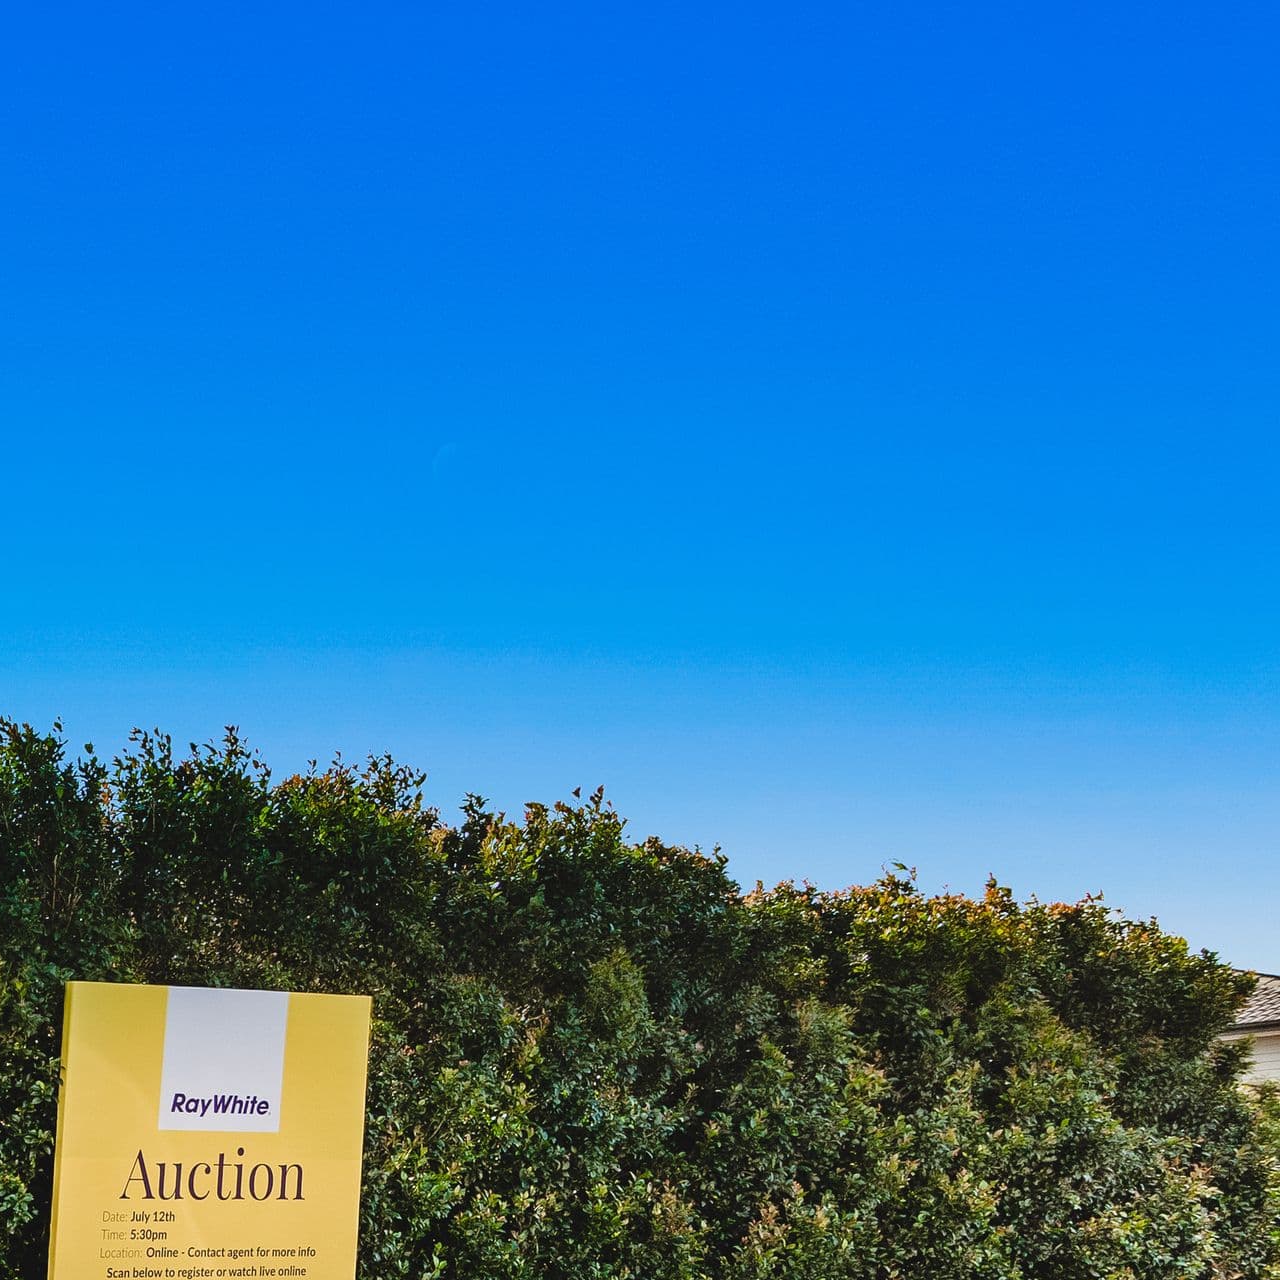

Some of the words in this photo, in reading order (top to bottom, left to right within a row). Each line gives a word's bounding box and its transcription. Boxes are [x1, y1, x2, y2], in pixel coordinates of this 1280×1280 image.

[119, 1147, 305, 1201] Auction
[102, 1210, 128, 1223] Date:
[130, 1211, 151, 1224] July
[153, 1211, 175, 1222] 12th
[101, 1228, 127, 1240] Time:
[130, 1229, 168, 1241] 5:30pm
[100, 1247, 143, 1259] Location:
[146, 1247, 179, 1258] Online
[187, 1247, 225, 1258] Contact
[227, 1247, 254, 1259] agent
[256, 1246, 270, 1257] for
[272, 1248, 296, 1257] more
[298, 1246, 316, 1257] info
[106, 1267, 130, 1278] Scan
[132, 1267, 162, 1278] below
[165, 1268, 175, 1277] to
[177, 1266, 214, 1279] register
[216, 1268, 226, 1277] or
[229, 1265, 257, 1277] watch
[259, 1265, 276, 1276] live
[278, 1265, 307, 1276] online
